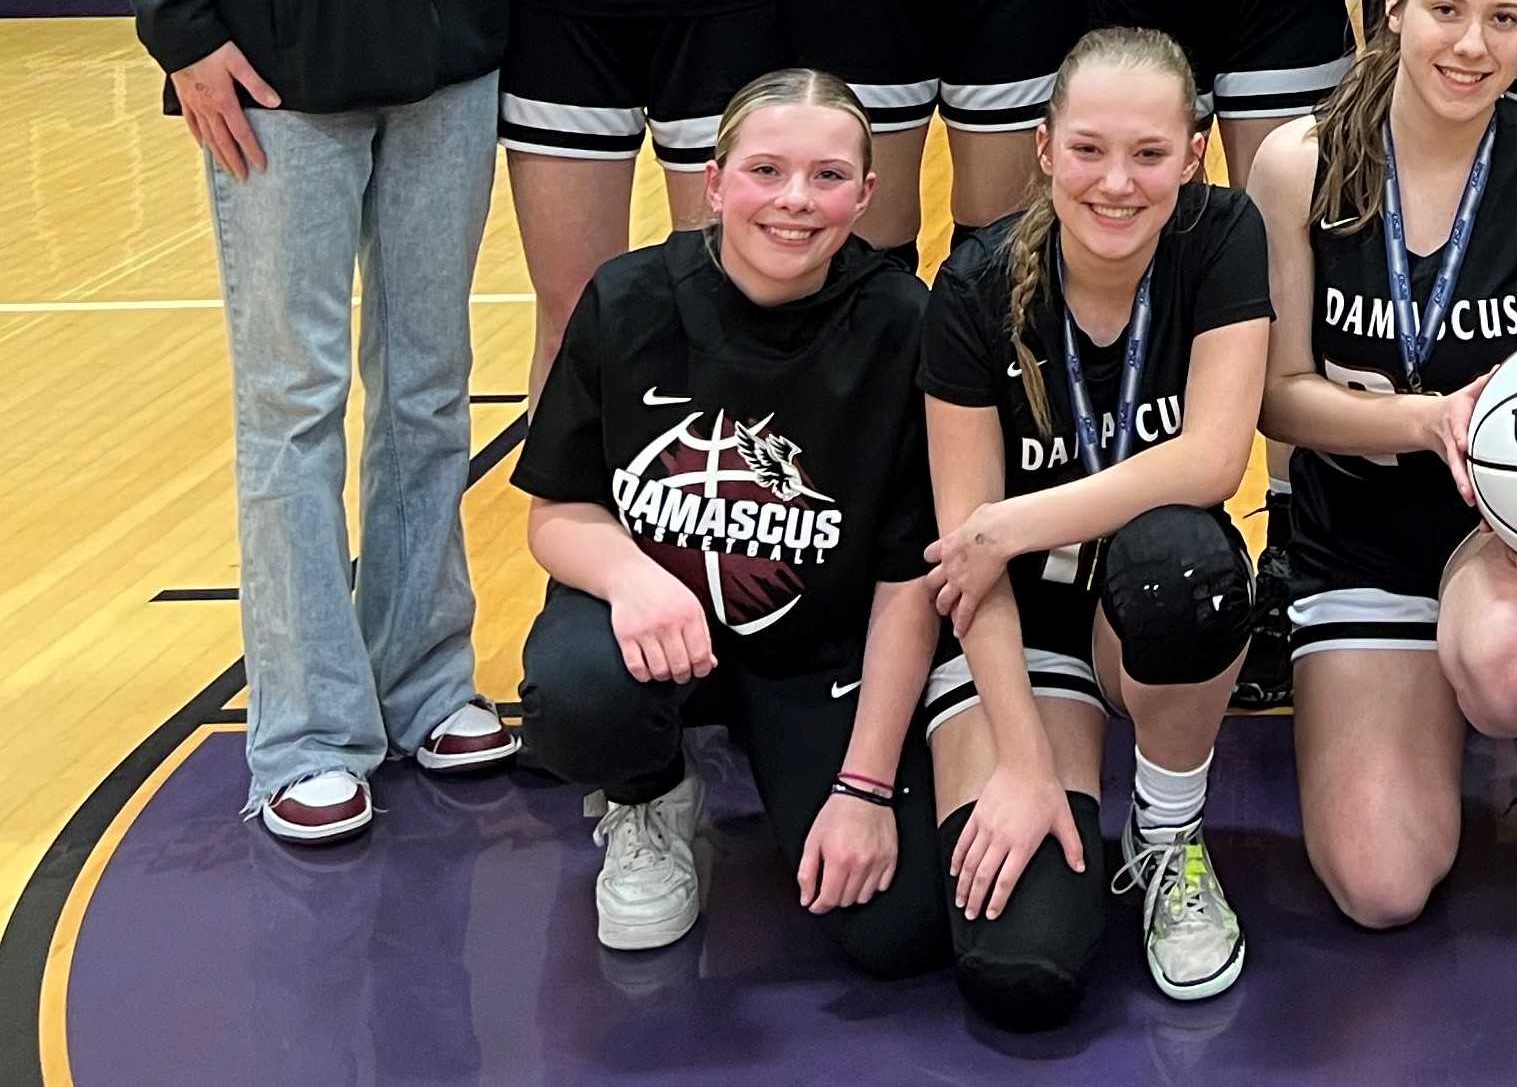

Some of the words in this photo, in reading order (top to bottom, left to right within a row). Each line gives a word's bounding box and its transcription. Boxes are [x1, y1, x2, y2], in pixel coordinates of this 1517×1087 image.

[1020, 394, 1183, 471] DAACU
[612, 467, 842, 550] DAMASCUS
[633, 518, 825, 565] ASKETBALL
